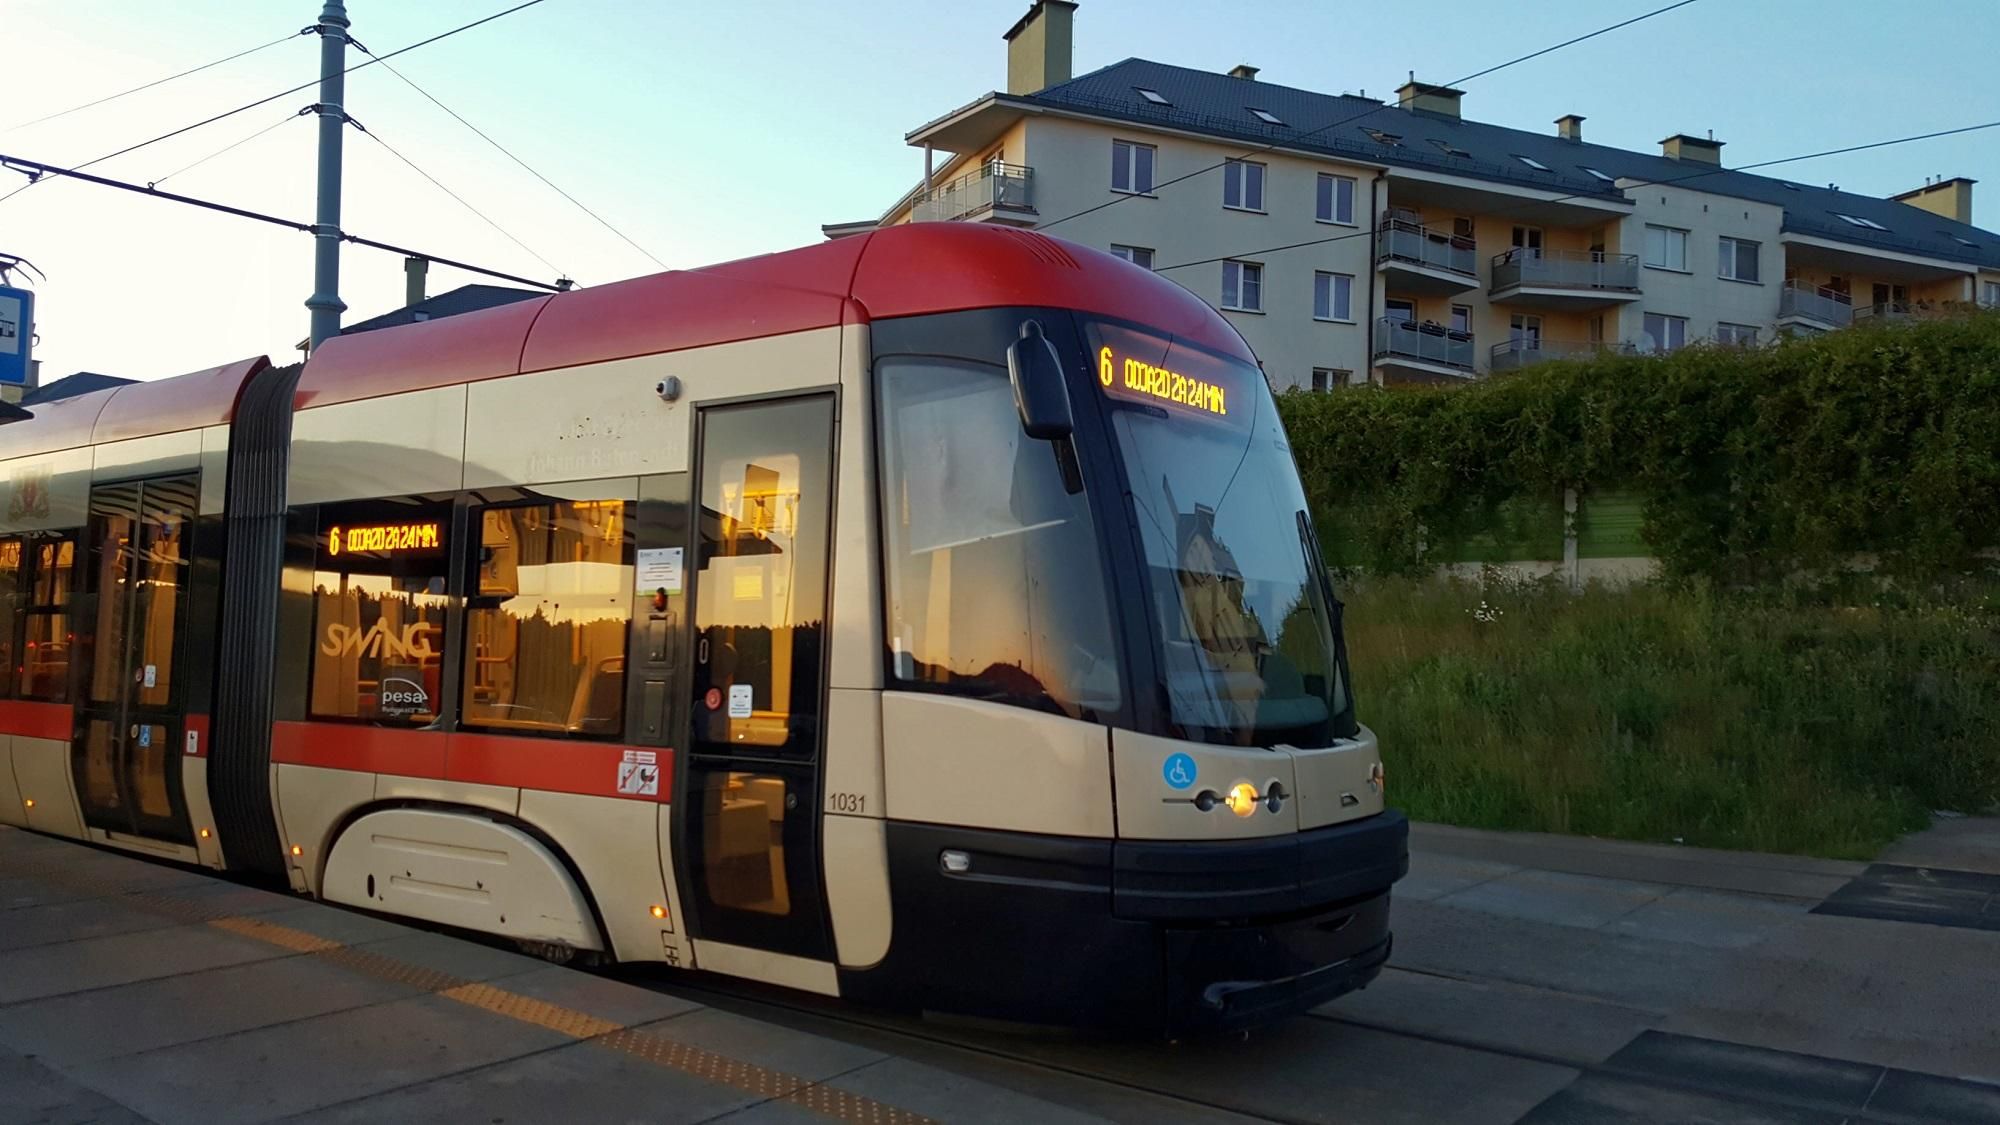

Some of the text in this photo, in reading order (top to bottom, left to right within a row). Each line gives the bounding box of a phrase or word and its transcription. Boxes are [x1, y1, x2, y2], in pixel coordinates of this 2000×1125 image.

[1100, 346, 1113, 387] 6
[1124, 358, 1170, 399] ODJAZD
[1171, 372, 1188, 404] ZA
[1187, 378, 1203, 409] 24
[329, 526, 340, 555] 6
[400, 525, 415, 549] 24
[382, 691, 423, 705] pesa
[830, 792, 865, 813] 1031
